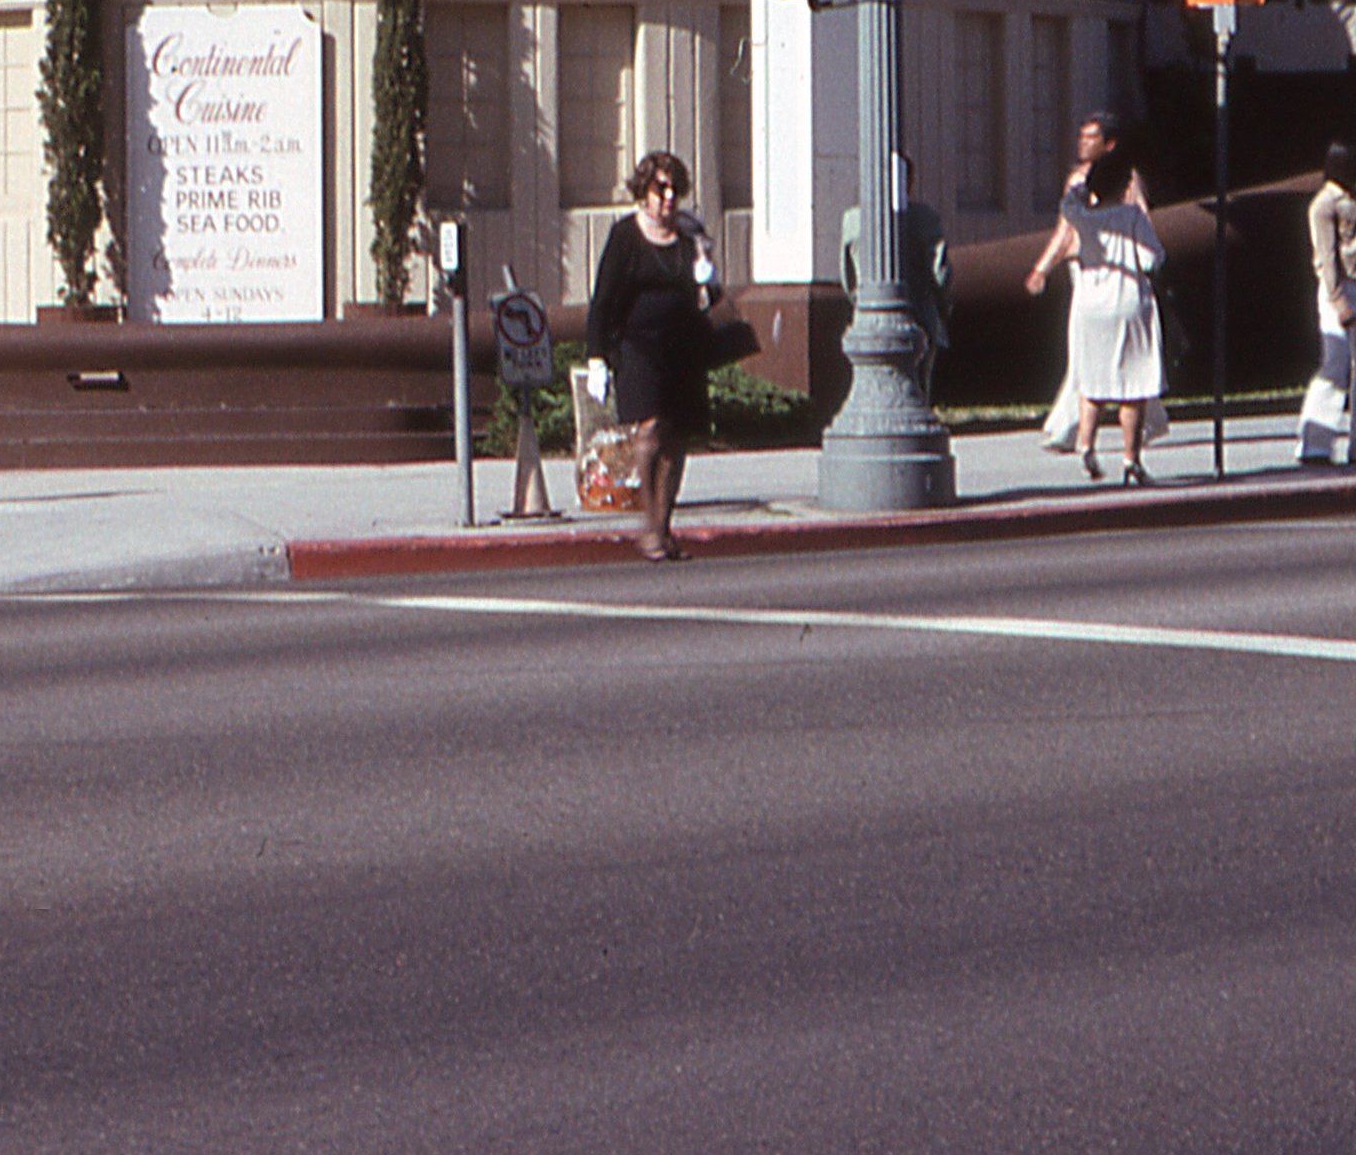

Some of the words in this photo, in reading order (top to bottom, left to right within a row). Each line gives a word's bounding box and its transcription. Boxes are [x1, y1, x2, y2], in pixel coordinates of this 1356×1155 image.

[151, 33, 303, 79] Continental
[164, 79, 268, 126] Cuisine
[175, 165, 264, 186] STEAKS
[175, 190, 239, 211] PRIME
[247, 190, 282, 211] RIB
[176, 214, 217, 235] SEA
